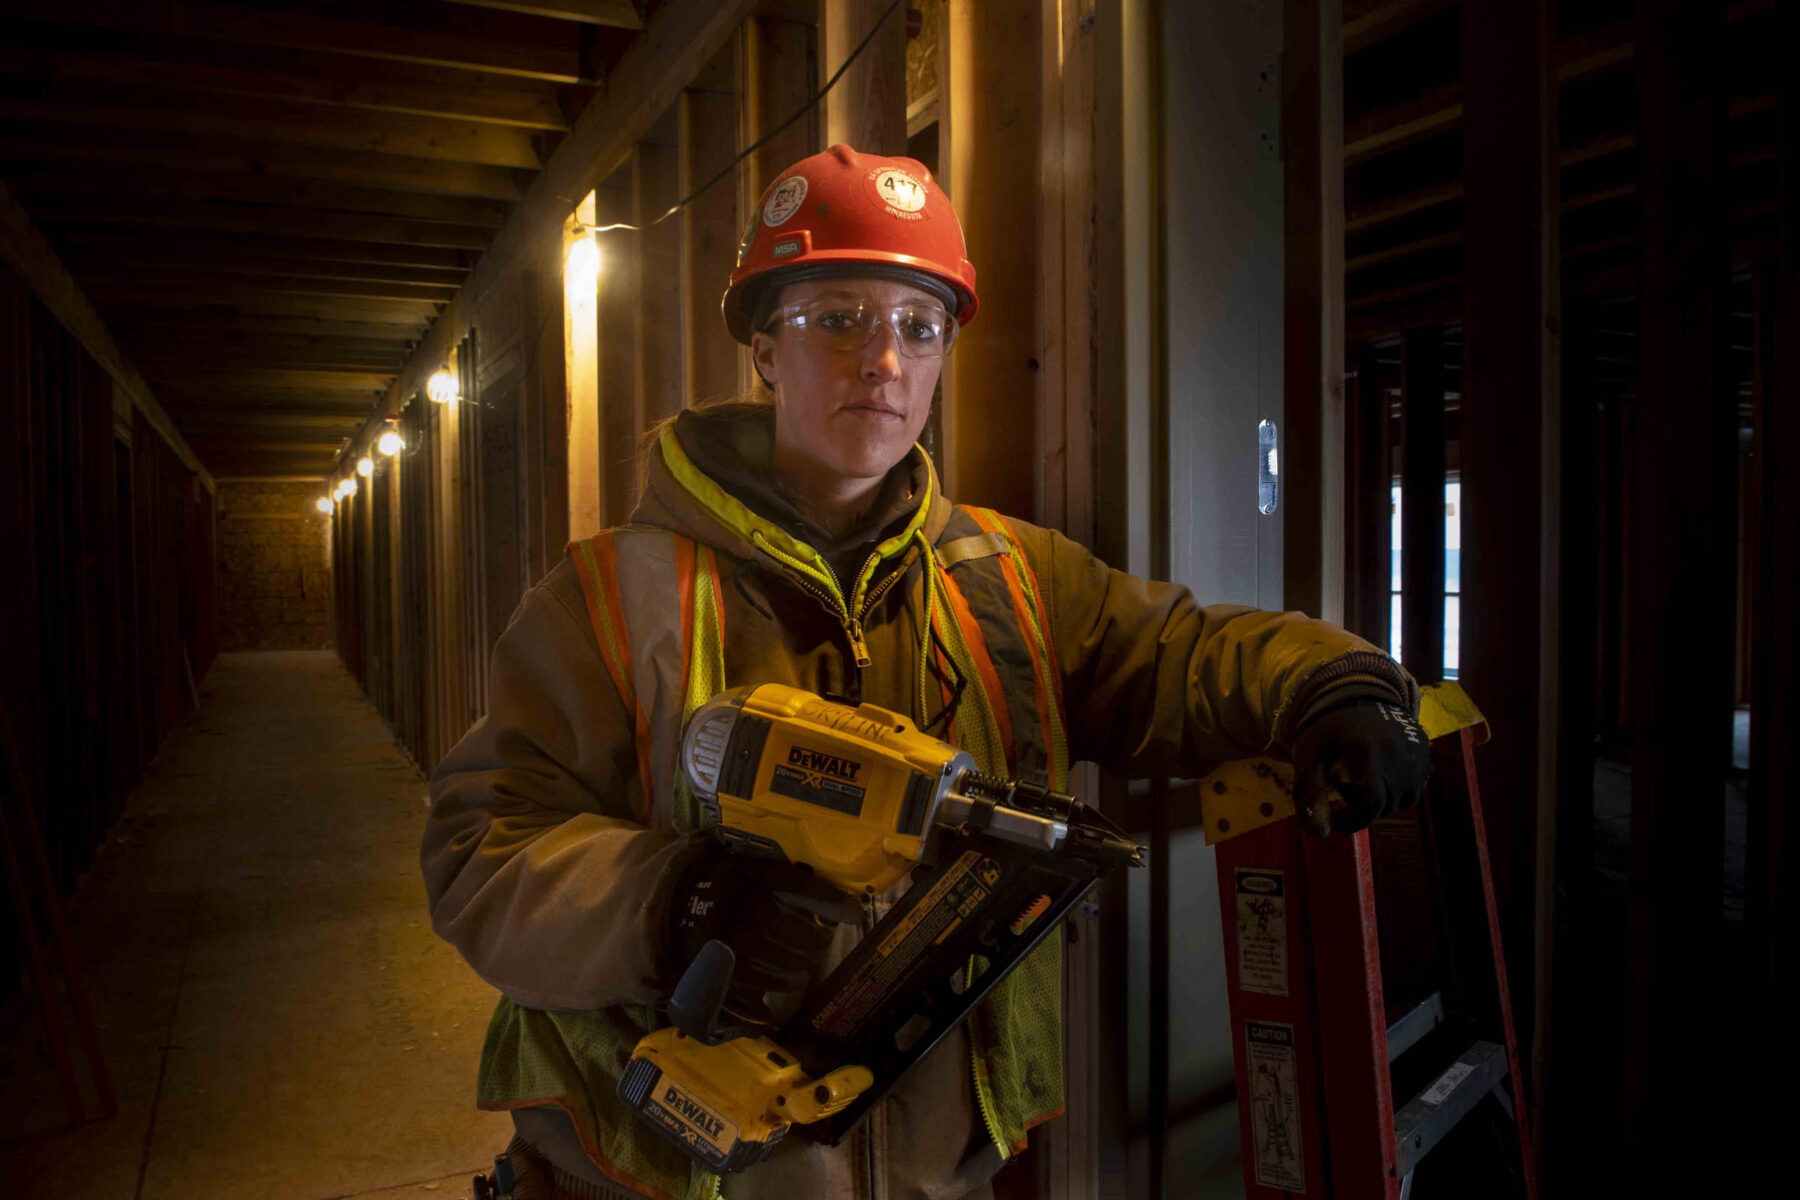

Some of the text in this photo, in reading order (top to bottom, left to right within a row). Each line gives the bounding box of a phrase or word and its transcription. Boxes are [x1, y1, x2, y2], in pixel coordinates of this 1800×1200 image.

[774, 242, 798, 255] MSA
[788, 748, 861, 780] DEWALT
[1251, 1026, 1289, 1042] CAUTION
[664, 1087, 724, 1139] DEWALT
